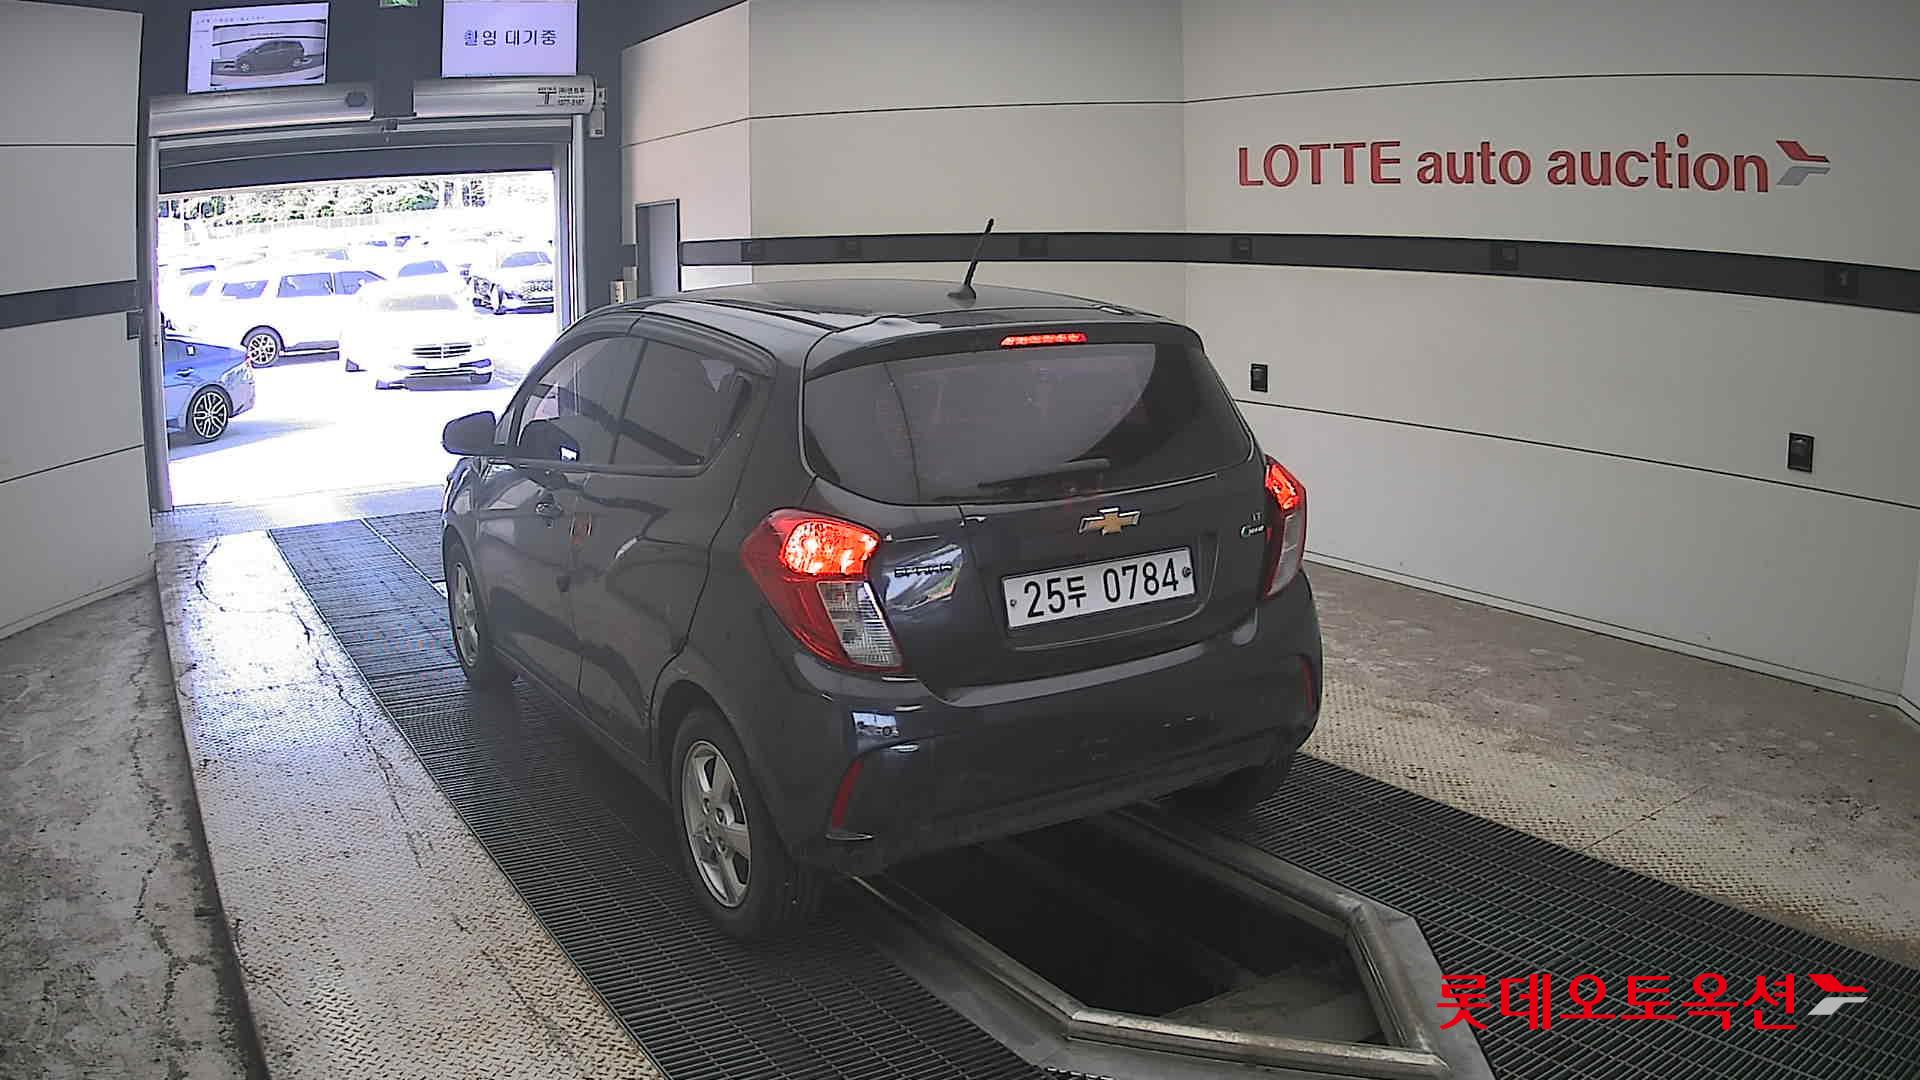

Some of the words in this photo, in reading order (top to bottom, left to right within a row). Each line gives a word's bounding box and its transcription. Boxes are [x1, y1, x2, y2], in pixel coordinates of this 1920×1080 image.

[505, 29, 557, 46] 대기중
[1238, 141, 1400, 187] LOTTE
[1417, 141, 1531, 185] auto
[1547, 133, 1768, 193] auction
[1023, 576, 1087, 618] 25두
[1103, 558, 1178, 602] 0784
